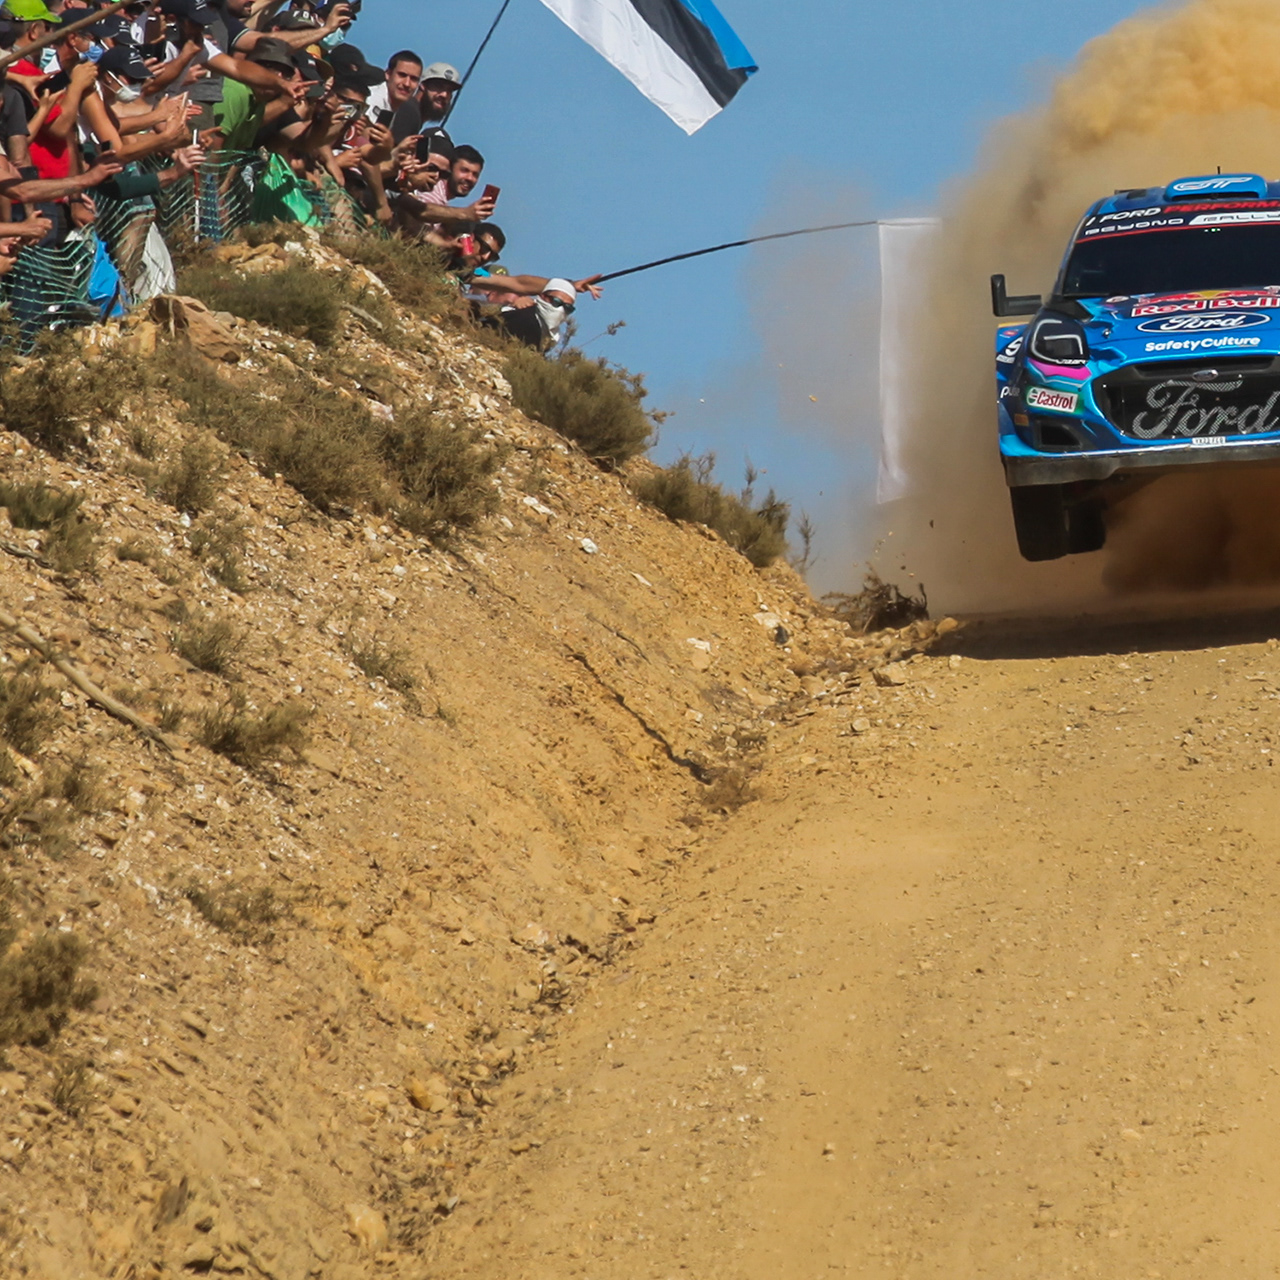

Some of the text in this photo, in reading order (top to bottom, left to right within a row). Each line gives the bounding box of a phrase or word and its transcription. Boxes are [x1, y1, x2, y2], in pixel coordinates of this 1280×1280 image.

[1099, 207, 1161, 223] FORD
[1131, 295, 1280, 317] Red Bull
[1159, 313, 1246, 331] Ford
[1145, 336, 1261, 352] SafetyCulture
[1036, 391, 1074, 409] Castrol
